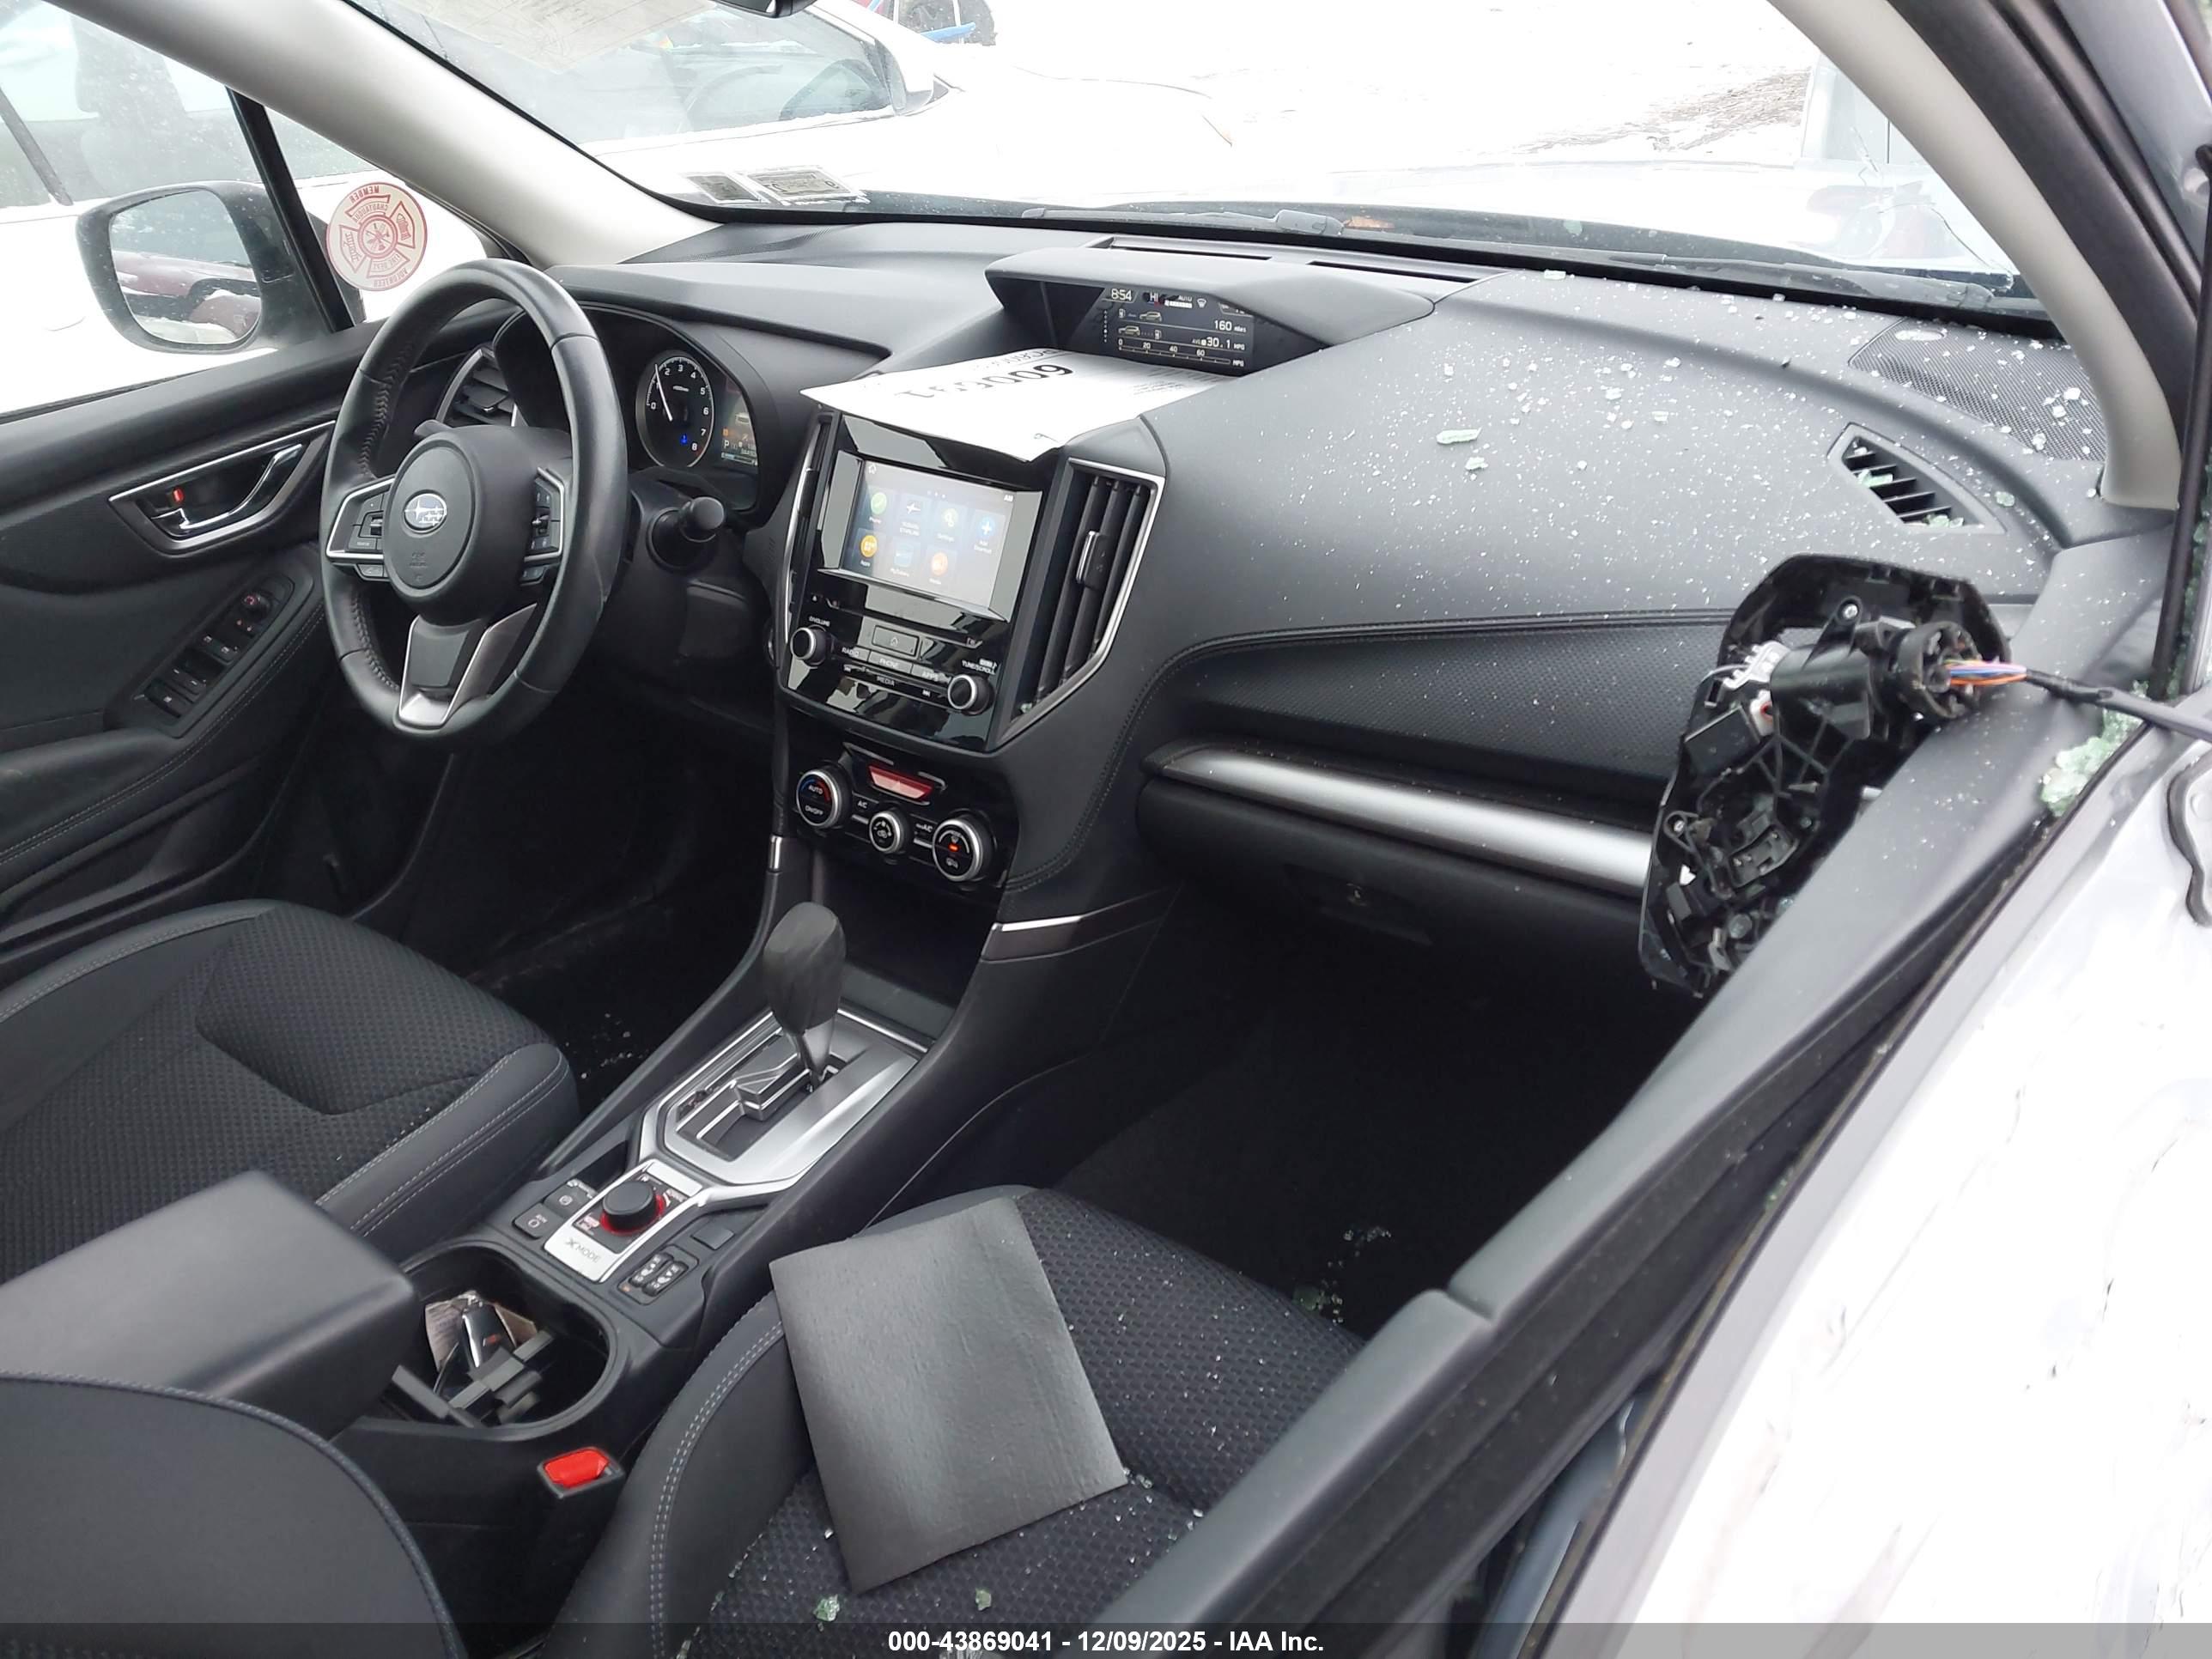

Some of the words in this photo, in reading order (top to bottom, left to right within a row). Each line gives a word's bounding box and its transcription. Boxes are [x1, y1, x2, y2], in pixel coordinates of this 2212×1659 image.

[1214, 319, 1232, 331] 160
[691, 442, 697, 451] 8
[842, 647, 860, 658] RADIO
[876, 676, 895, 686] MEDIA
[921, 671, 939, 682] APPS
[808, 784, 823, 794] AUTO
